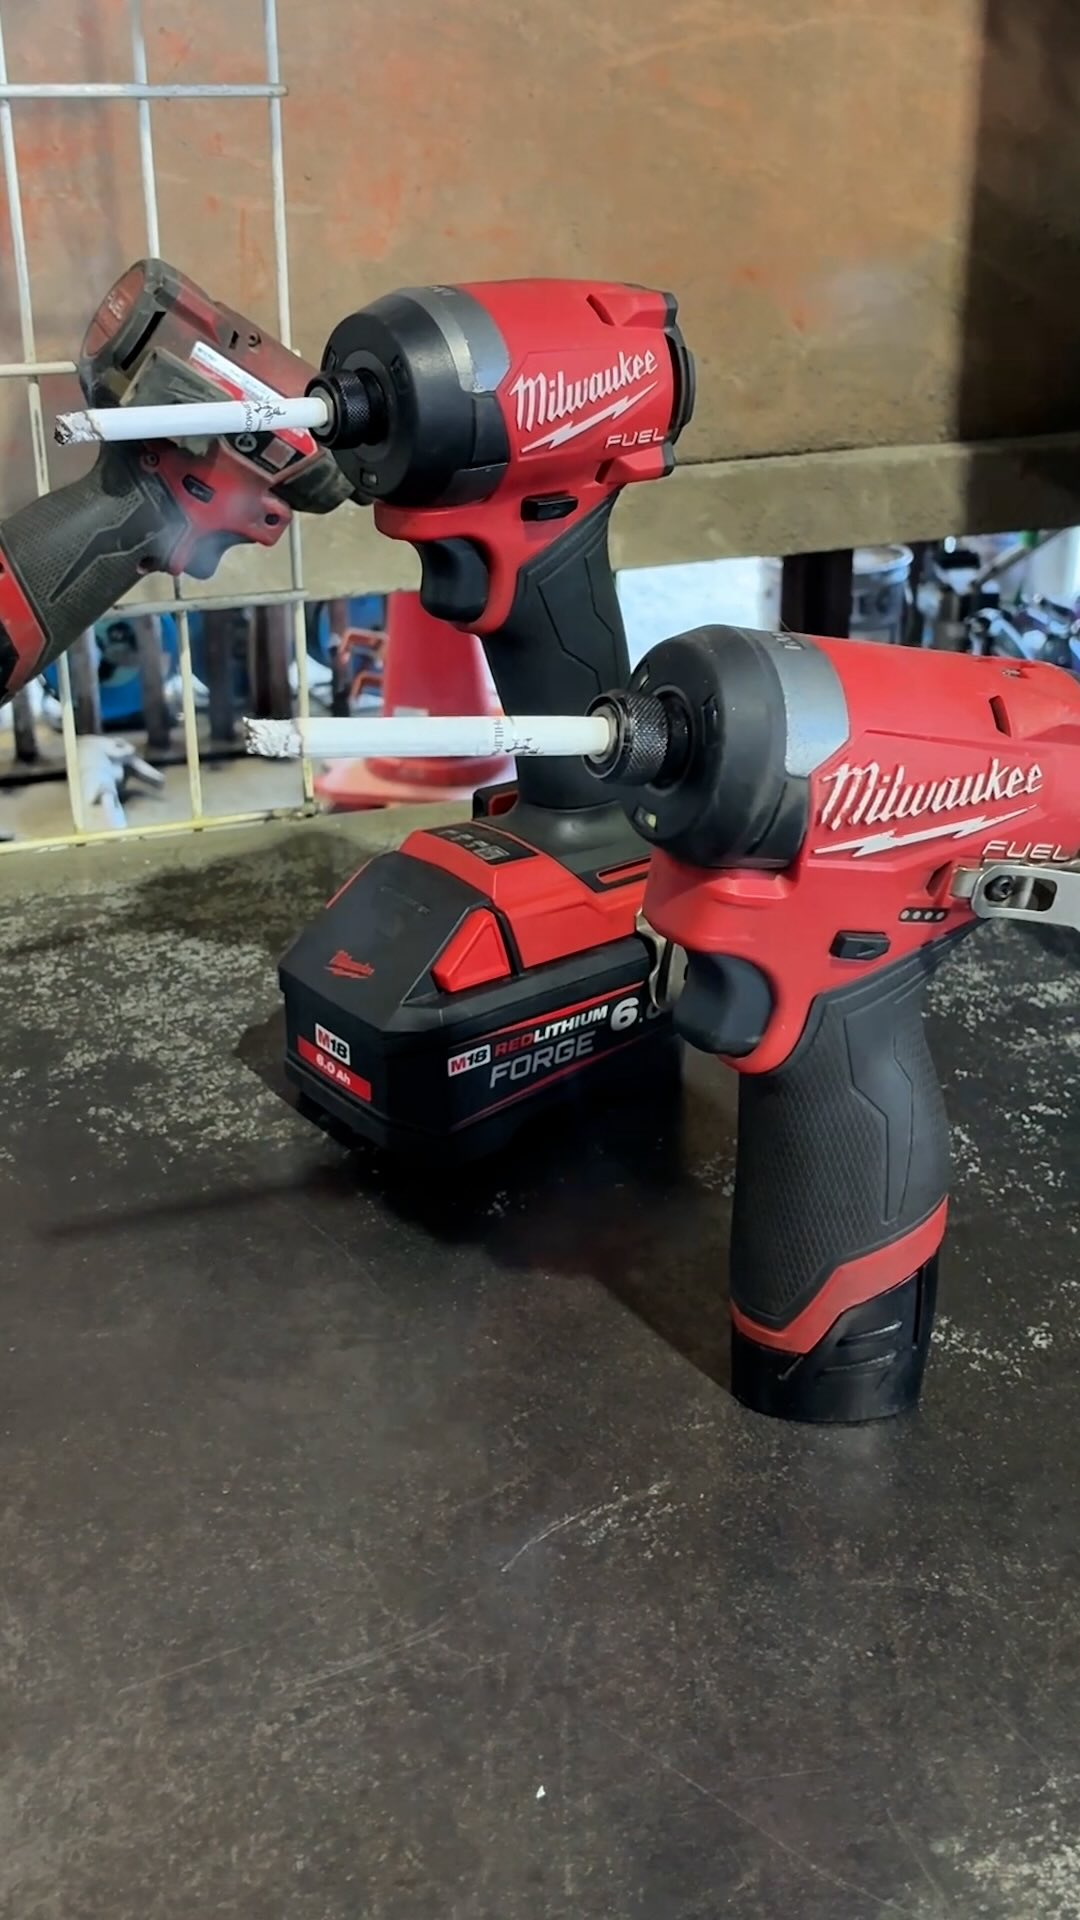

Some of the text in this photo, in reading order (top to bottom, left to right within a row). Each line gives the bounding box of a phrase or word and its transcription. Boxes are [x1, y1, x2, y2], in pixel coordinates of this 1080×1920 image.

[509, 350, 658, 432] Milwaukee
[605, 428, 665, 449] FUEL
[820, 758, 1043, 831] Milwaukee
[982, 840, 1071, 861] FUEL
[317, 1028, 348, 1059] M18
[450, 1049, 488, 1073] M18
[494, 1005, 609, 1057] REDLITHIUM
[489, 1030, 597, 1088] FORGE
[336, 1070, 352, 1086] Ah
